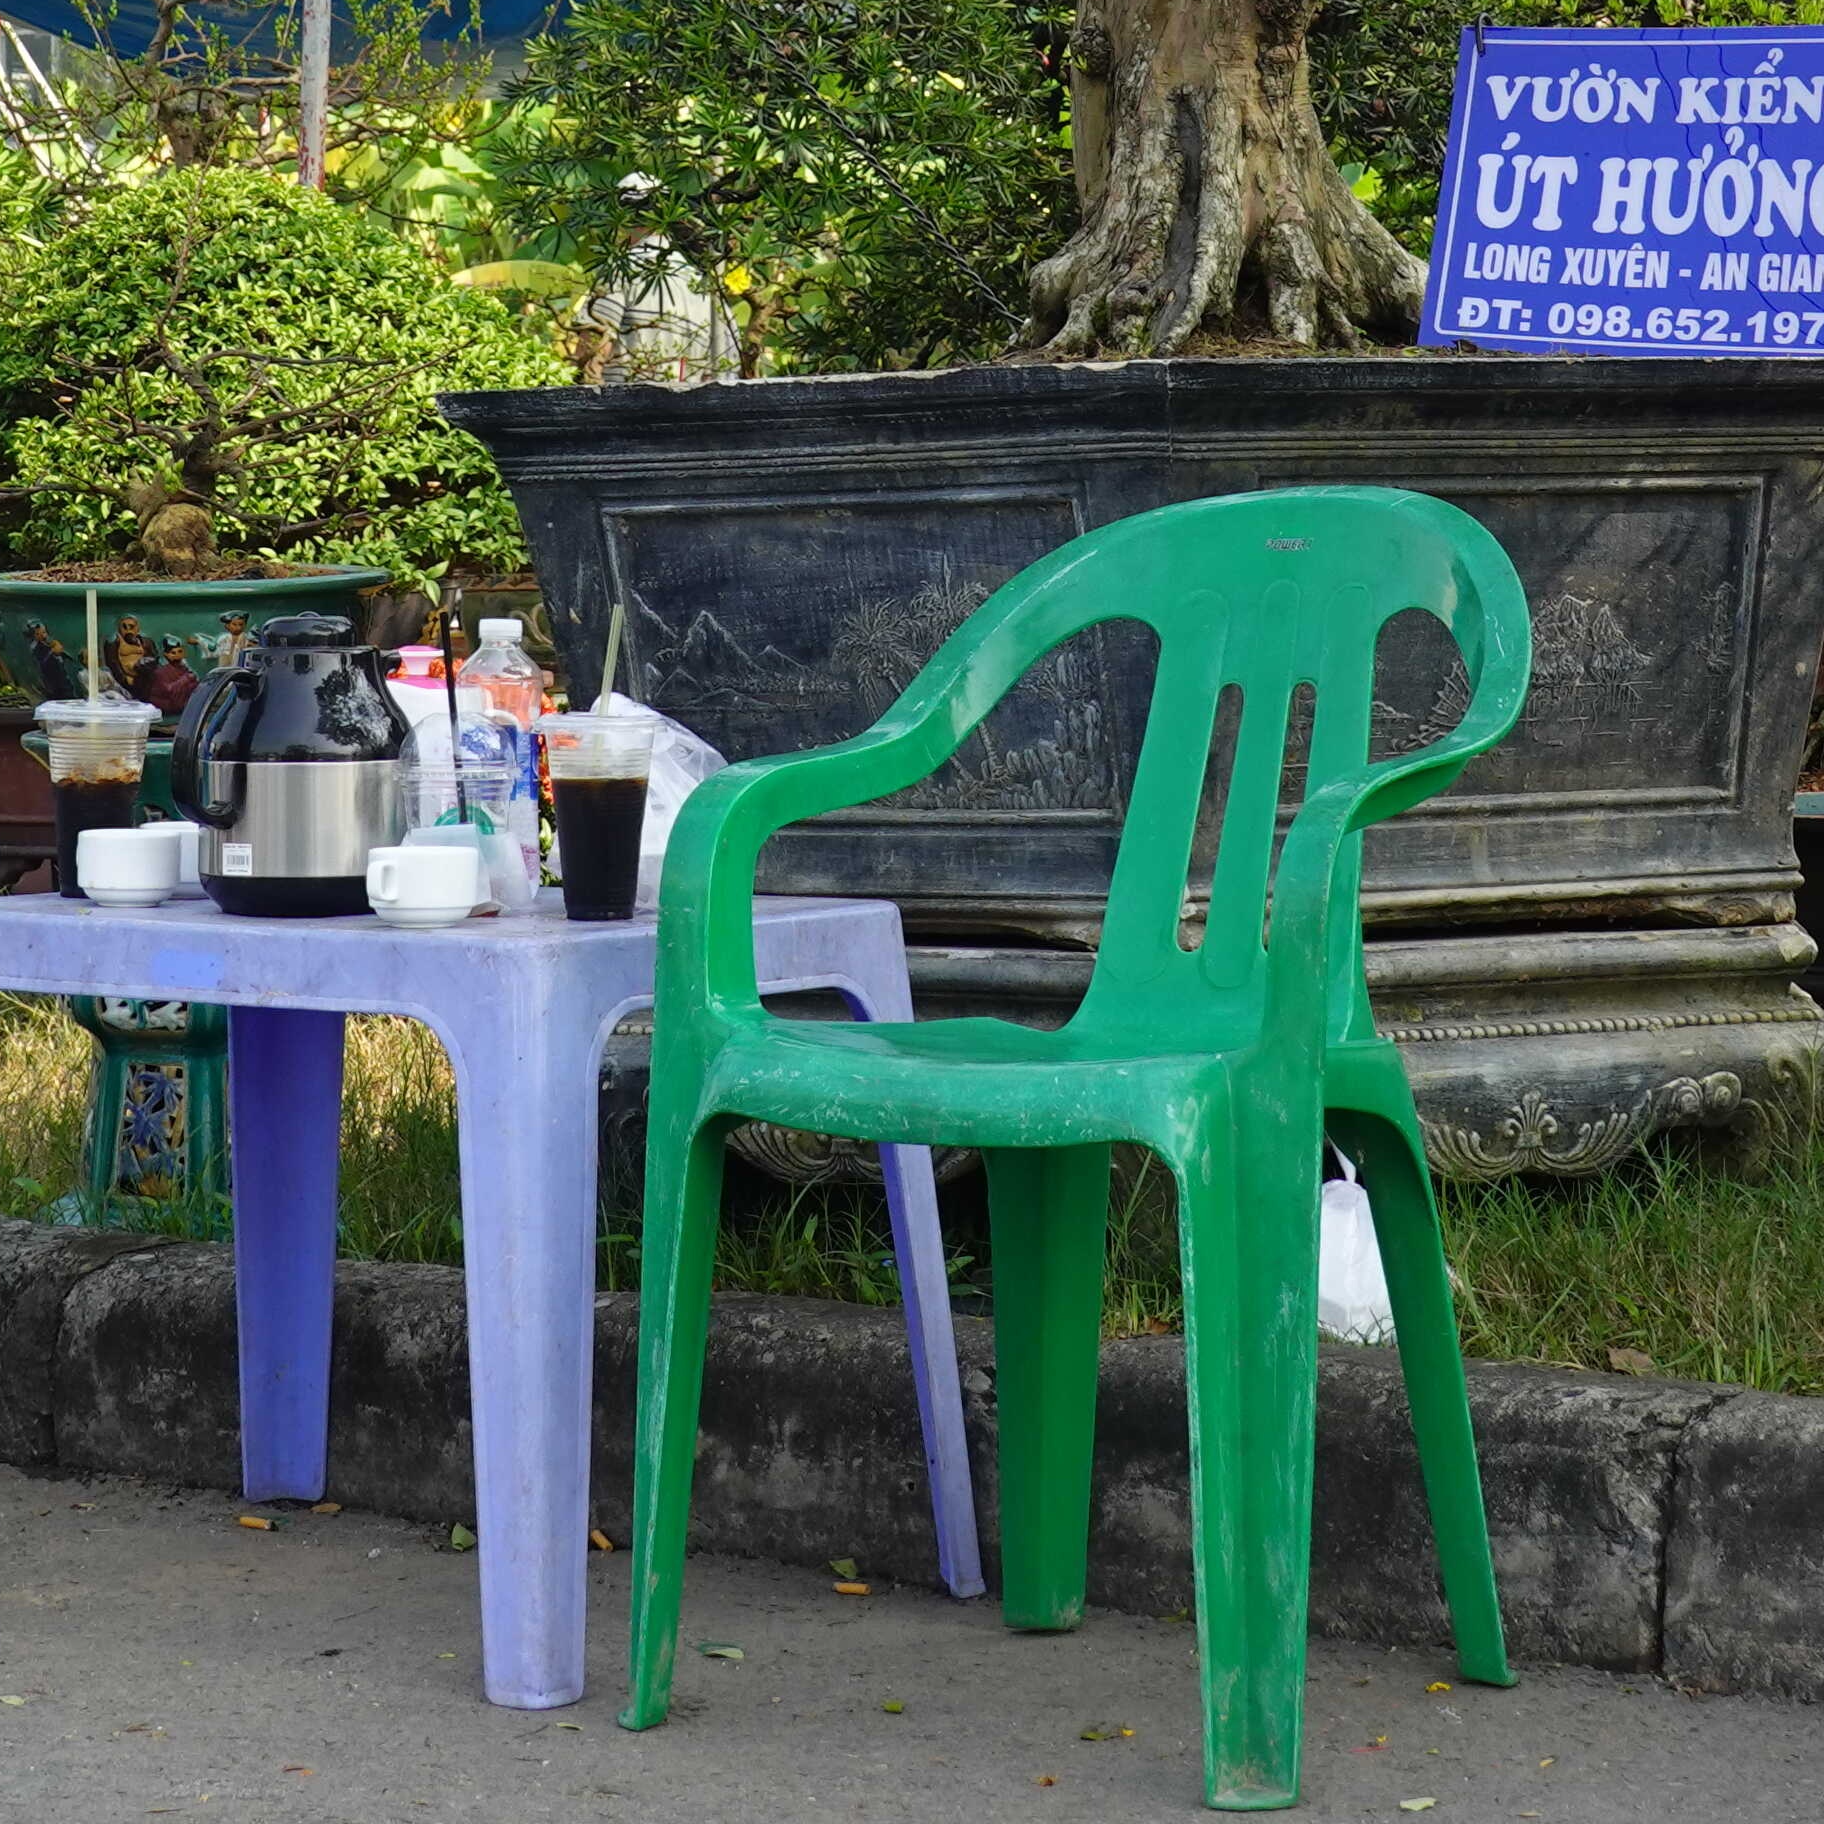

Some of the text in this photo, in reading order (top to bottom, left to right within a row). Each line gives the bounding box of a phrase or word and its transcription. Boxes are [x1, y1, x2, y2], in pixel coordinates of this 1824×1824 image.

[1485, 64, 1661, 124] VƯỜN
[1477, 132, 1578, 232] ÚT
[1464, 243, 1552, 284] LONG
[1560, 243, 1670, 289] XUYÊN
[1679, 267, 1692, 277] -
[1700, 252, 1750, 291] AN
[1457, 297, 1531, 333] ĐT:
